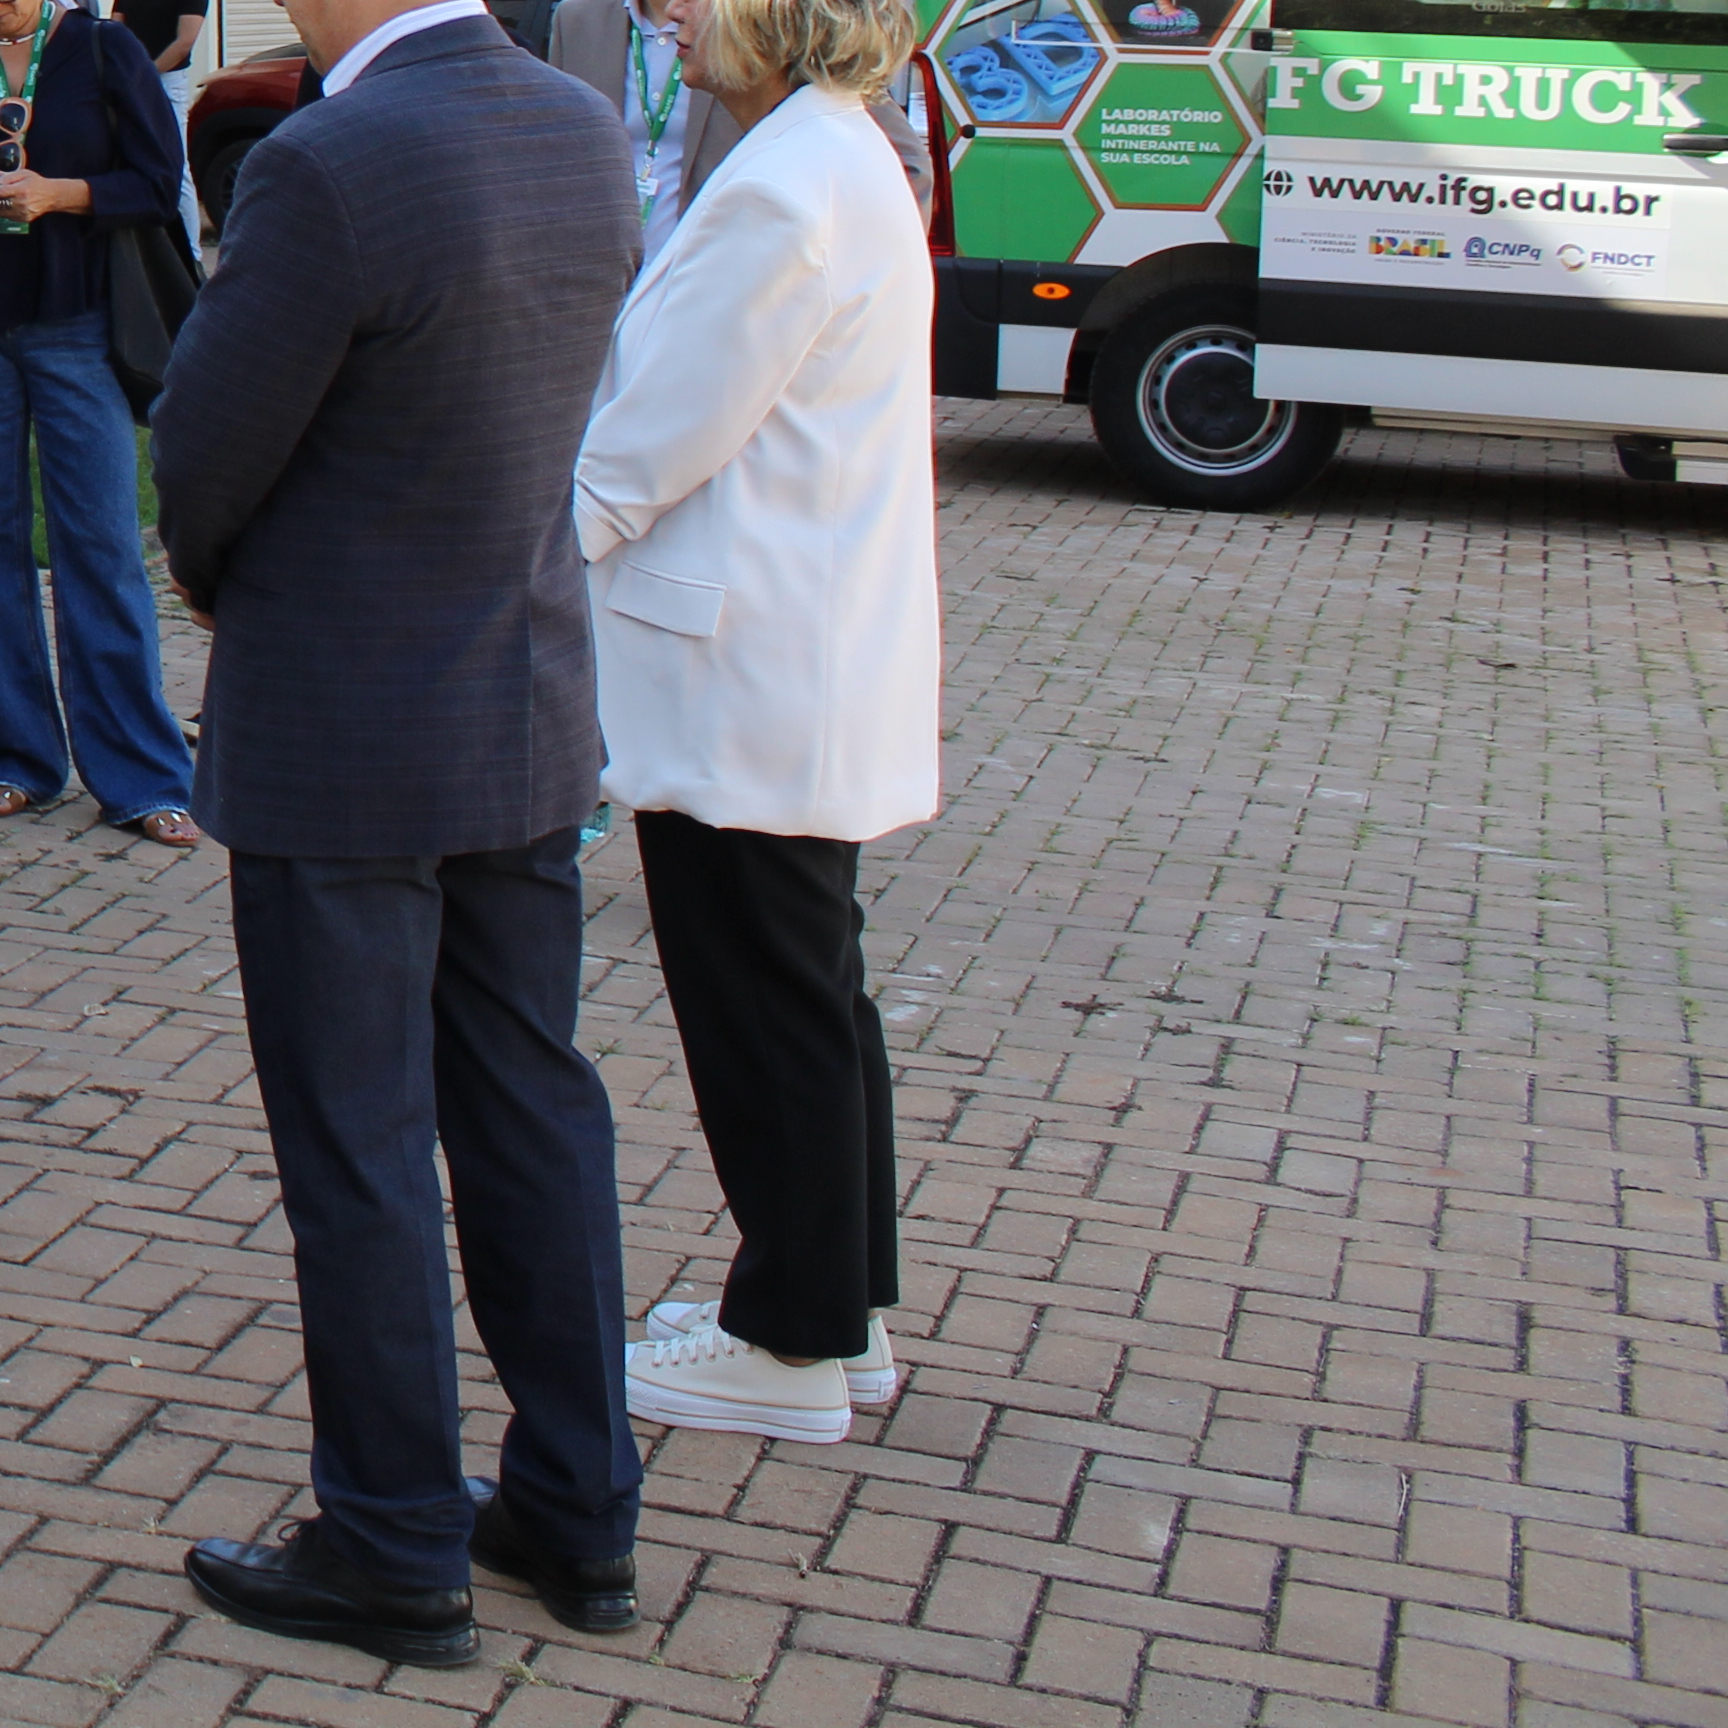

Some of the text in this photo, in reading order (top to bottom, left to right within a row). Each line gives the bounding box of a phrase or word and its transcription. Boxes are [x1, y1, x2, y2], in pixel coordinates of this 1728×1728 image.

[1268, 56, 1703, 128] FG TRUCK
[1101, 107, 1223, 123] LABORATÓRIO
[1101, 123, 1172, 136] MARKES
[1101, 139, 1221, 152] INTINERANTE NA
[1101, 152, 1191, 165] SUA ESCOLA
[1307, 173, 1660, 217] www.ifg.edu.br
[1368, 235, 1452, 259] BRASIL
[1488, 242, 1543, 261] CNPq
[1591, 252, 1656, 267] FNDCT
